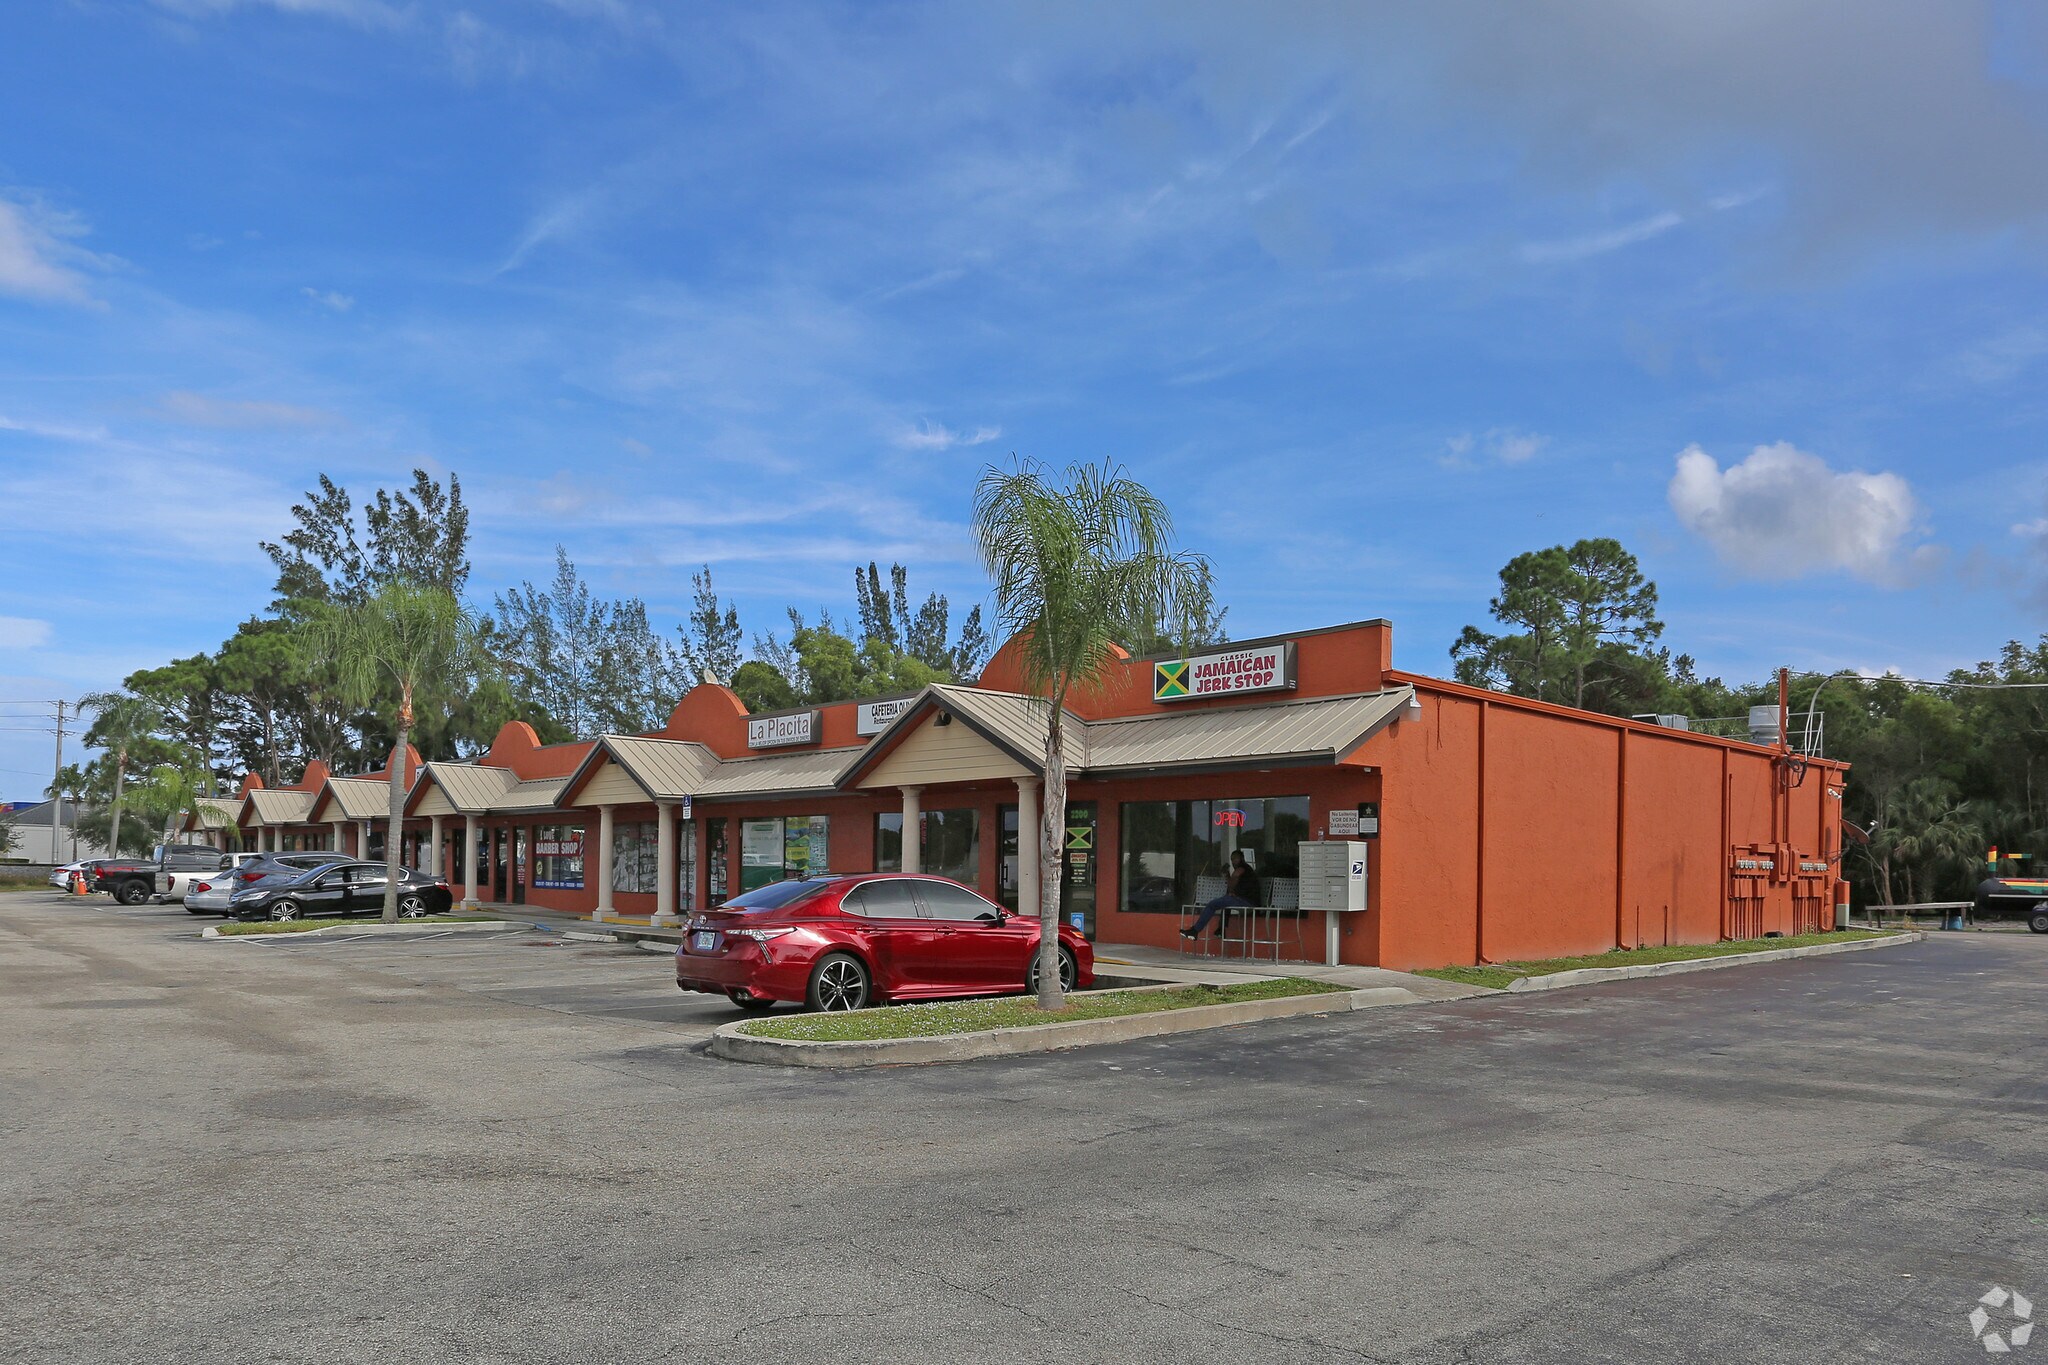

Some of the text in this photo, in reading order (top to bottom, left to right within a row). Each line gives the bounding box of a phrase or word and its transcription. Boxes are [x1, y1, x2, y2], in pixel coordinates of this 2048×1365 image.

[1220, 652, 1253, 662] CLASSIC
[1194, 655, 1276, 679] JAMAICAN
[1196, 676, 1231, 693] JERK
[1234, 671, 1274, 689] STOP
[871, 702, 898, 717] CAFETERIA
[750, 715, 809, 740] La Placita
[1214, 811, 1245, 827] OPEN
[536, 842, 578, 854] BARBER SHOP
